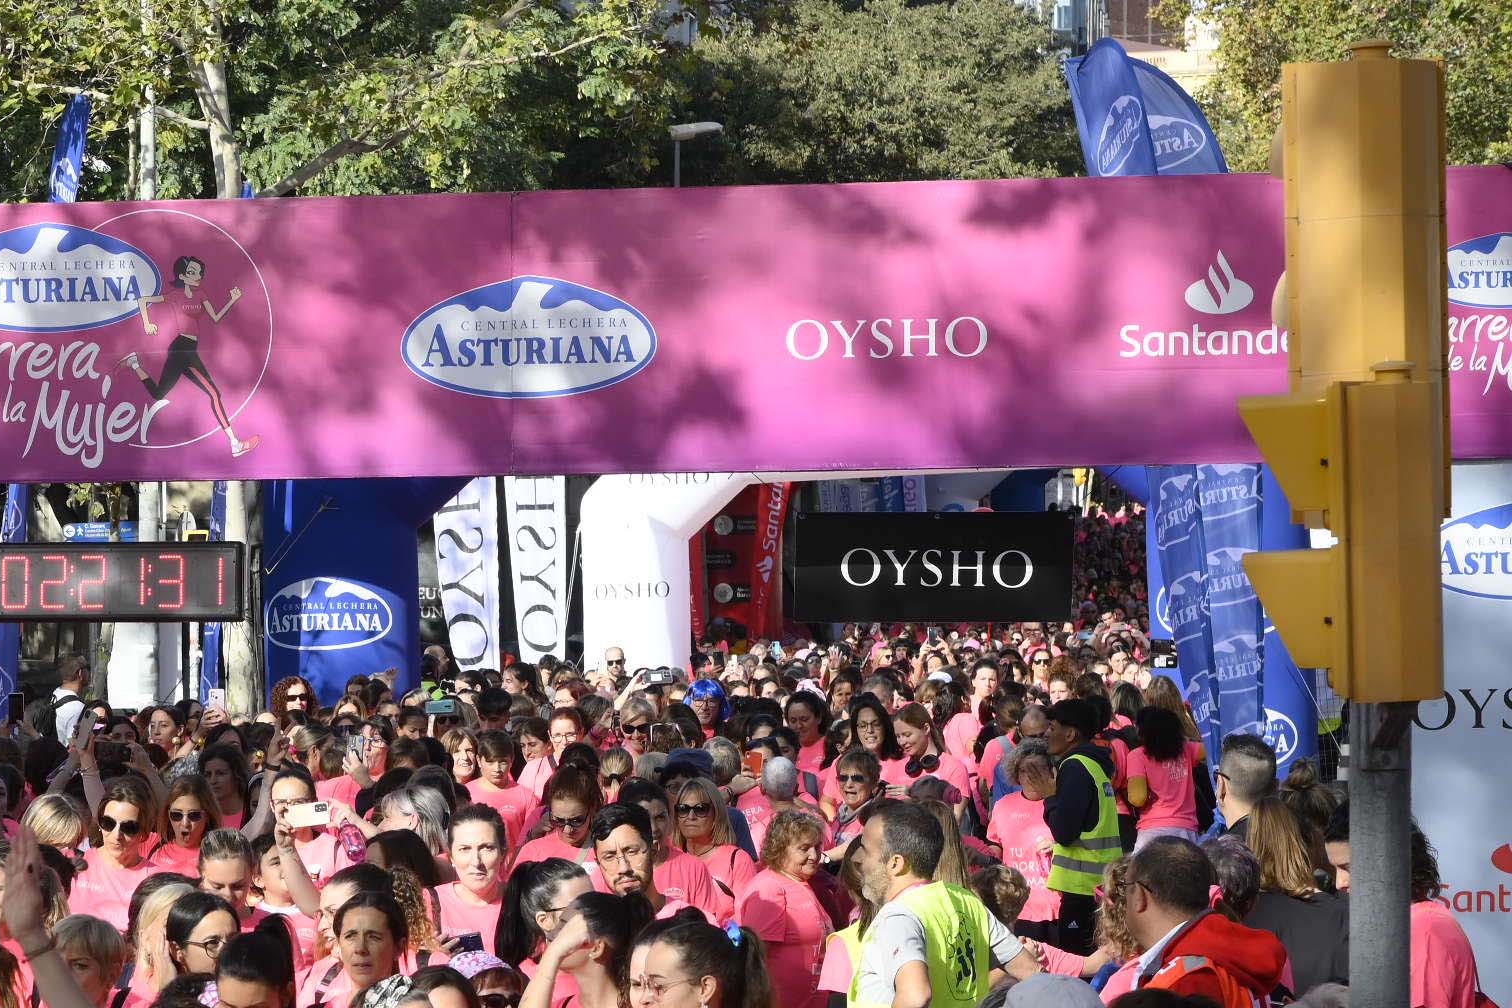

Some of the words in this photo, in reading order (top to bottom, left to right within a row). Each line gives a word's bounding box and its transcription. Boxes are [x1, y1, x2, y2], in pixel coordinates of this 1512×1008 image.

[63, 259, 136, 271] LECHERA
[461, 318, 538, 332] CENTRAL
[547, 316, 628, 330] LECHERA
[421, 323, 637, 369] ASTURIANA
[786, 316, 988, 361] OYSHO
[1469, 344, 1487, 372] la
[3, 383, 26, 423] la
[22, 376, 170, 469] Mujer
[841, 548, 1033, 588] OYSHO
[593, 580, 670, 600] OYSHO
[282, 602, 325, 611] CENTRAL
[330, 601, 378, 611] LECHERA
[270, 607, 384, 634] ASTURIANA
[1009, 847, 1023, 858] TU
